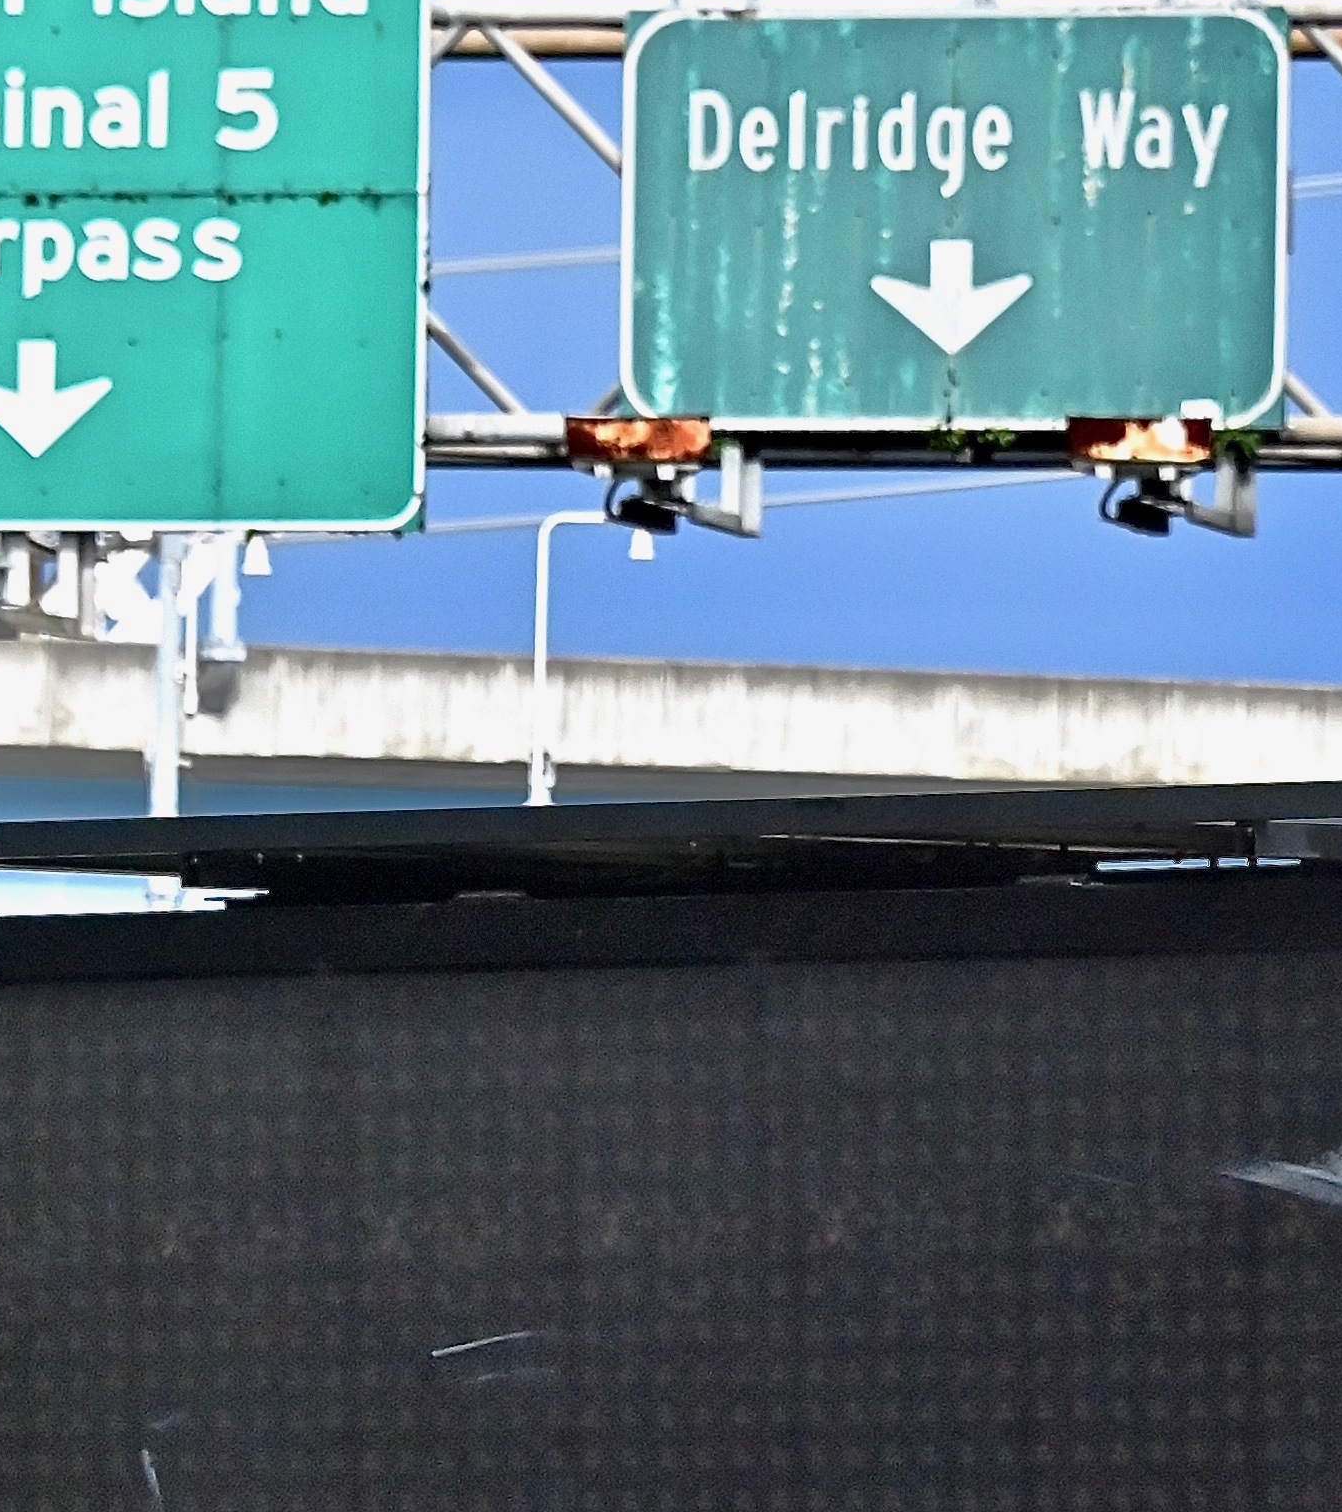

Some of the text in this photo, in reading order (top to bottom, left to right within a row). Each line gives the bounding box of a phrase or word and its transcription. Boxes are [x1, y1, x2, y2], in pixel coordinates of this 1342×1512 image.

[215, 68, 281, 152] 5
[687, 88, 1230, 198] Delridge Way
